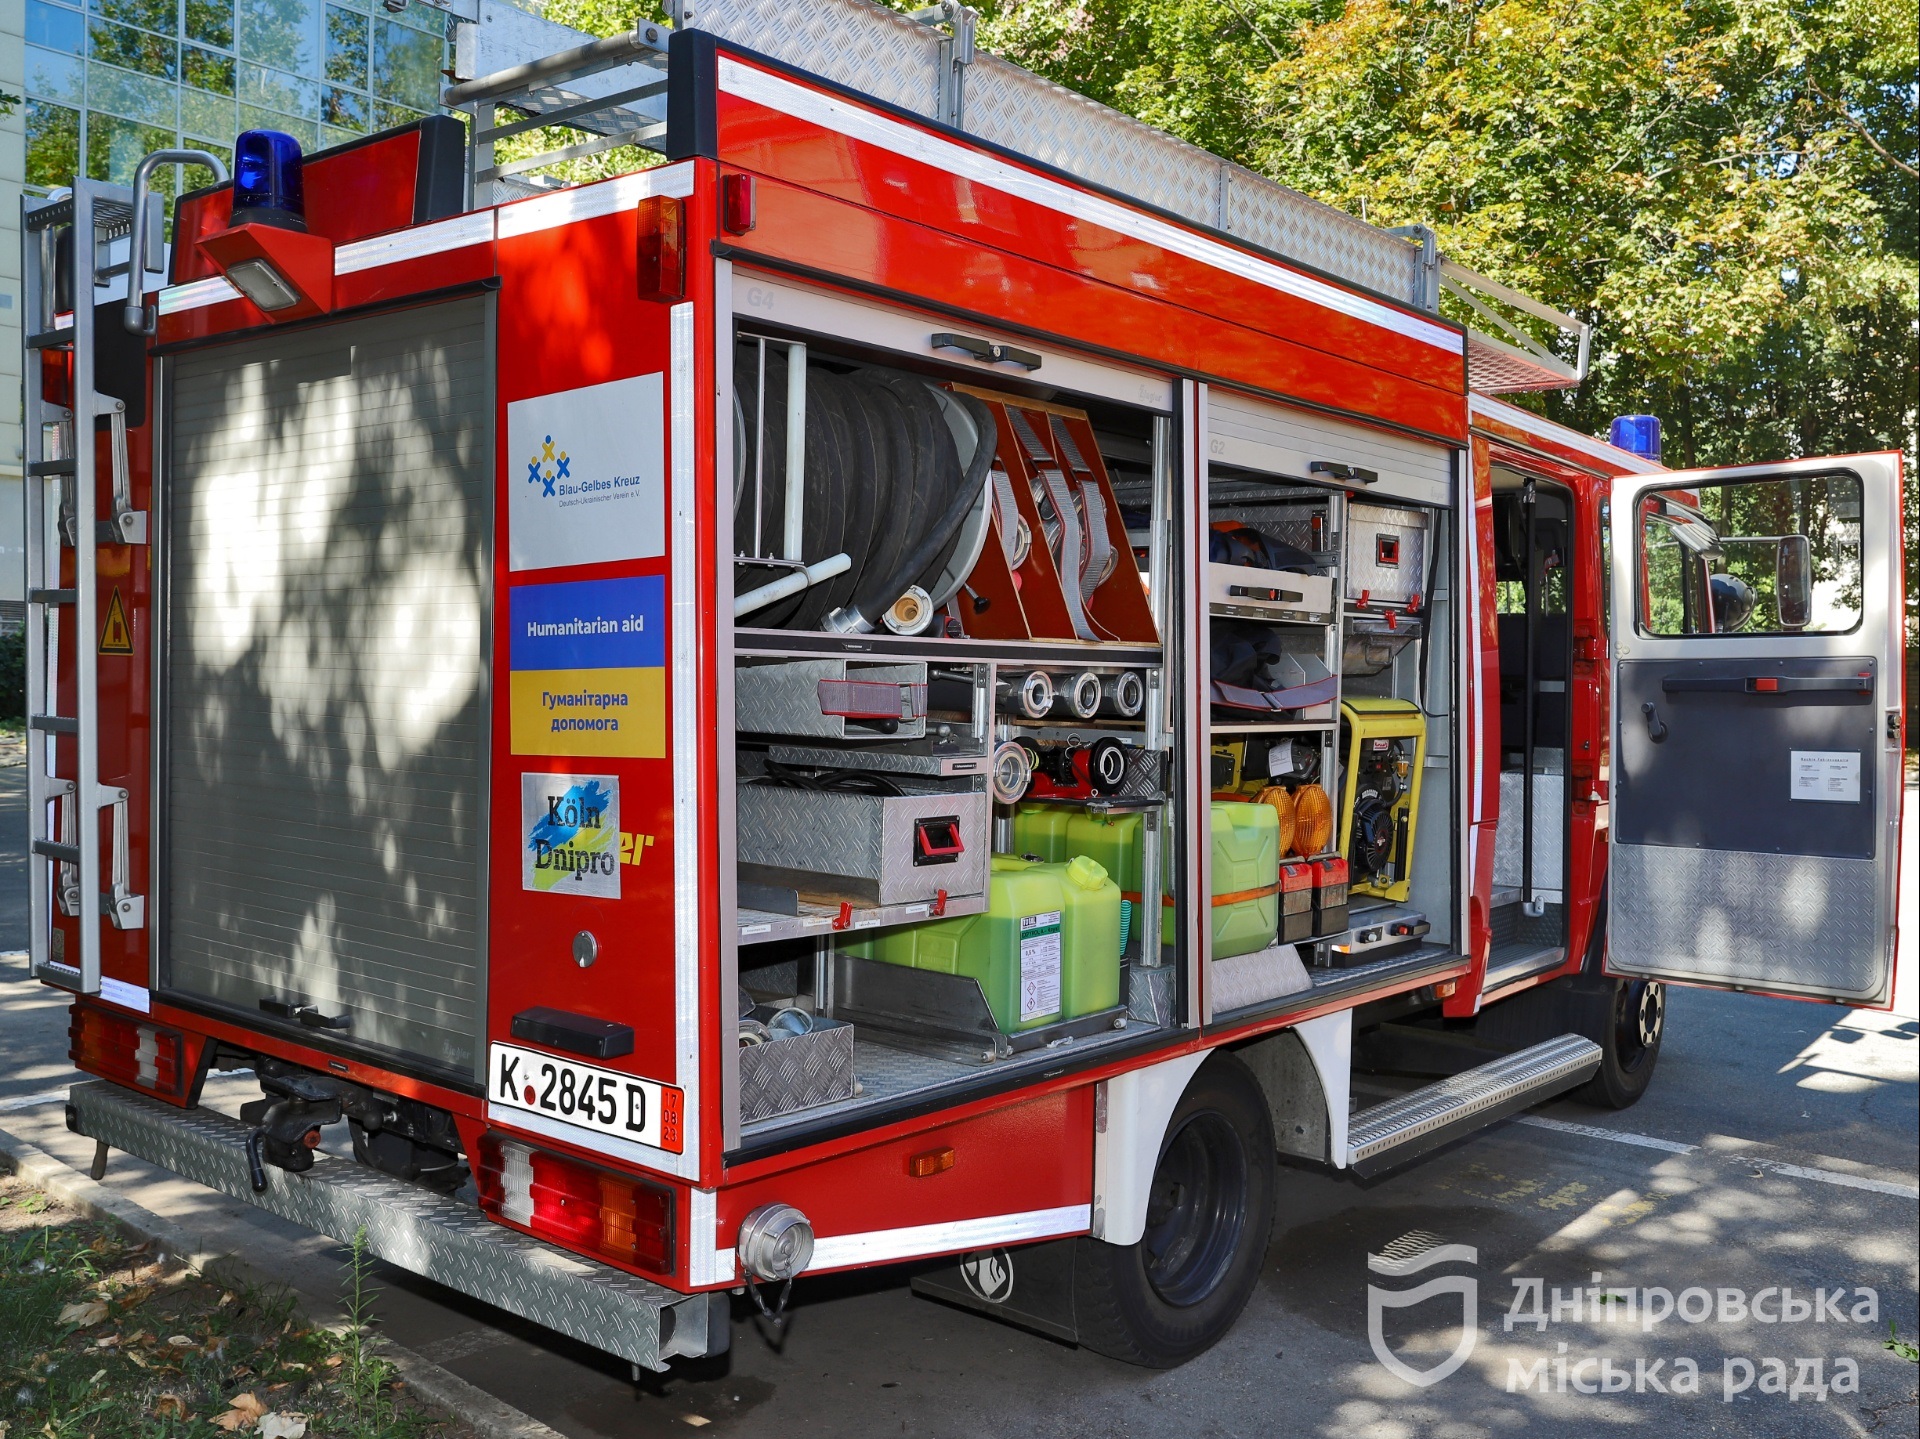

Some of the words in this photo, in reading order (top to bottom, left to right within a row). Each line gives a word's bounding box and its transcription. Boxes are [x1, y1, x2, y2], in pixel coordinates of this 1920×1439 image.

[746, 286, 775, 310] G4
[1210, 439, 1226, 456] G2
[559, 478, 612, 496] Blau-Gelbes
[614, 475, 641, 488] Kreuz
[558, 493, 612, 508] Deutsch-Ukrainischer
[613, 491, 630, 502] Verein
[527, 615, 617, 637] Humanitarian
[622, 614, 644, 633] aid
[542, 689, 628, 710] Гуманітарна
[551, 717, 619, 733] допомога
[547, 795, 601, 829] Köln
[534, 838, 615, 881] Dnipro
[499, 1053, 520, 1101] K
[540, 1063, 617, 1125] 2845
[626, 1083, 646, 1133] D
[665, 1092, 678, 1108] 17
[664, 1109, 678, 1125] 08
[663, 1126, 678, 1142] 23
